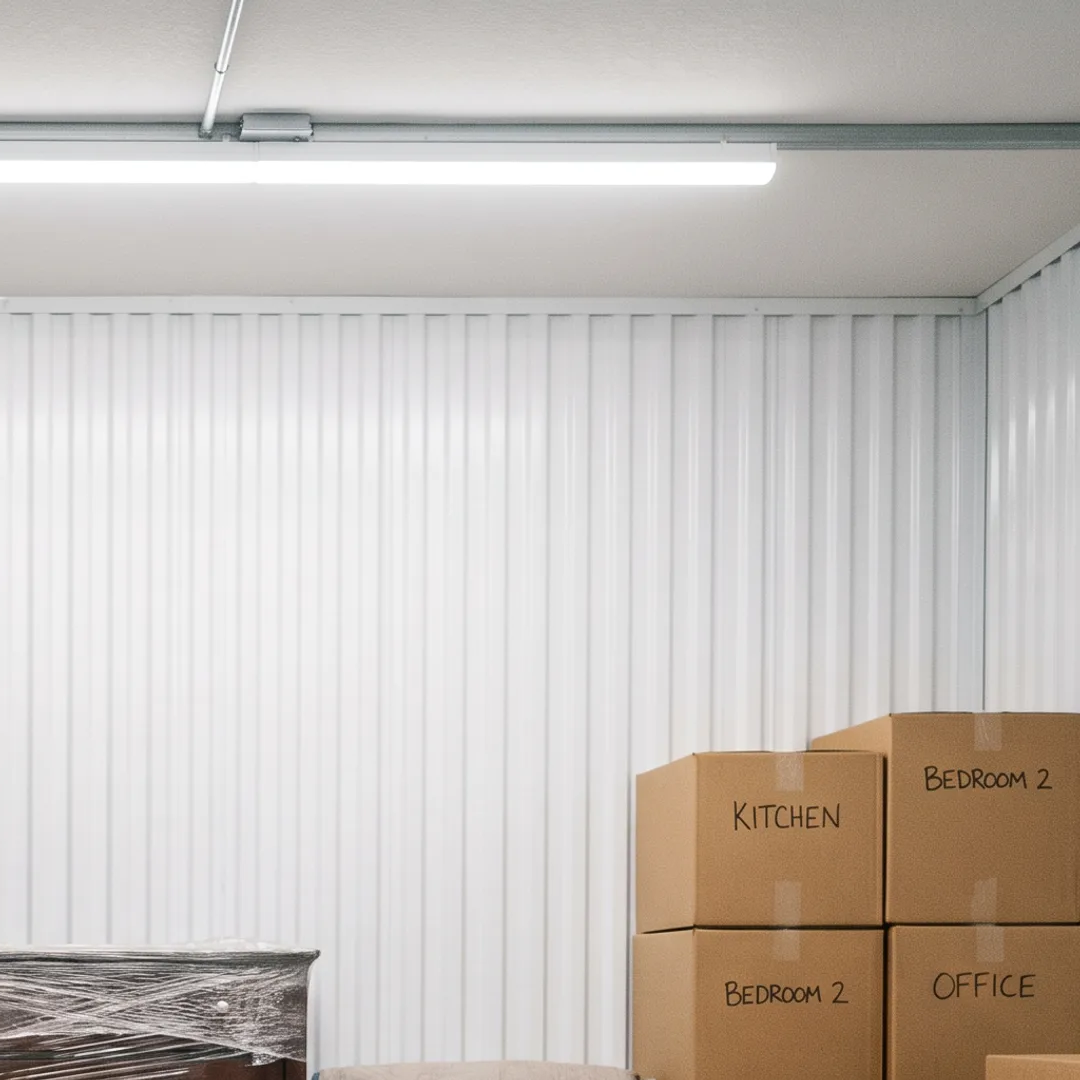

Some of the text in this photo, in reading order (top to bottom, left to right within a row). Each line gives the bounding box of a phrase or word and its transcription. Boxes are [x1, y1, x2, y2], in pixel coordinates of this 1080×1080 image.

[924, 765, 1053, 791] BEDROOM 2
[733, 801, 841, 831] KITCHEN
[724, 980, 849, 1007] BEDROOM 2
[932, 972, 1037, 1001] OFFICE
